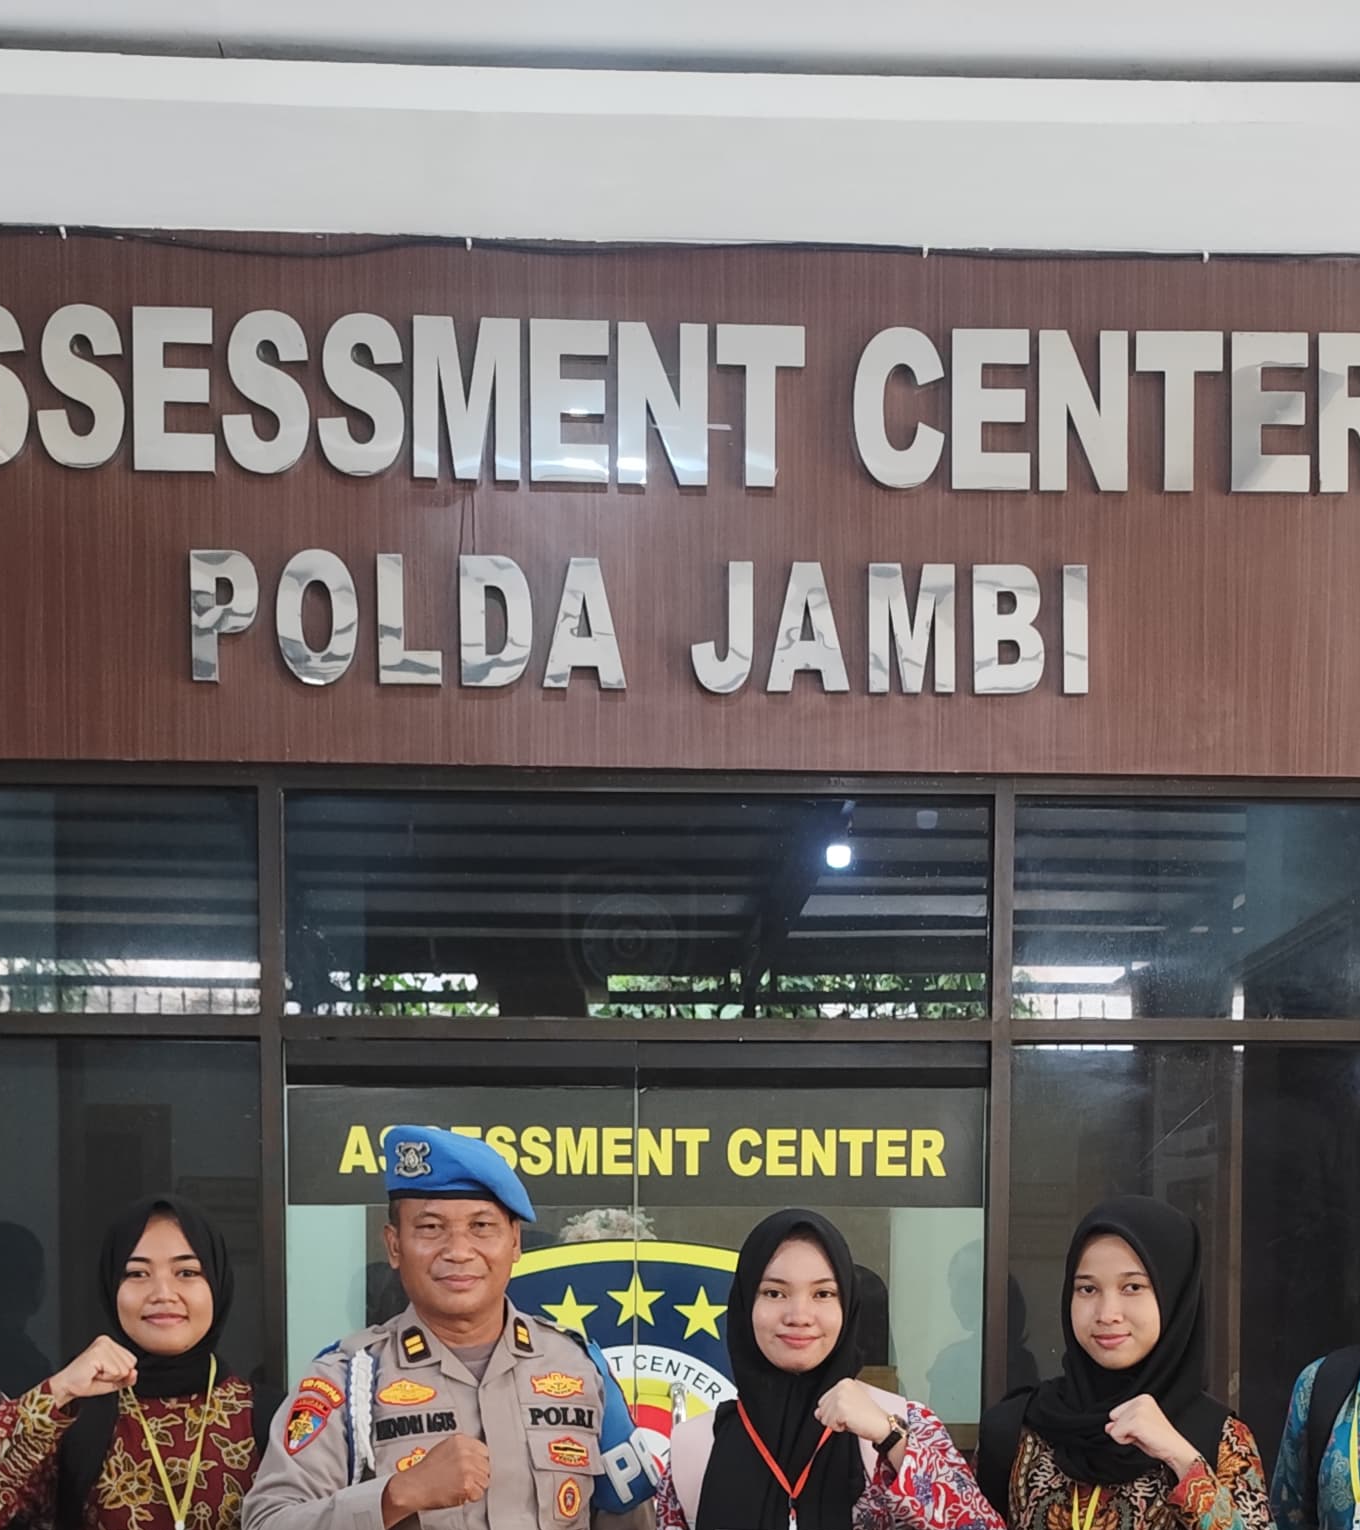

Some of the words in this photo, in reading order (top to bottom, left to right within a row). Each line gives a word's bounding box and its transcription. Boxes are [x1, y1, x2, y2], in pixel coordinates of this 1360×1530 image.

[190, 549, 626, 691] POLDA
[691, 560, 1088, 695] JAMBI
[339, 1126, 710, 1176] ASSMENT
[727, 1128, 946, 1176] CENTER
[634, 1354, 721, 1401] CENTER
[529, 1406, 594, 1429] POLRI
